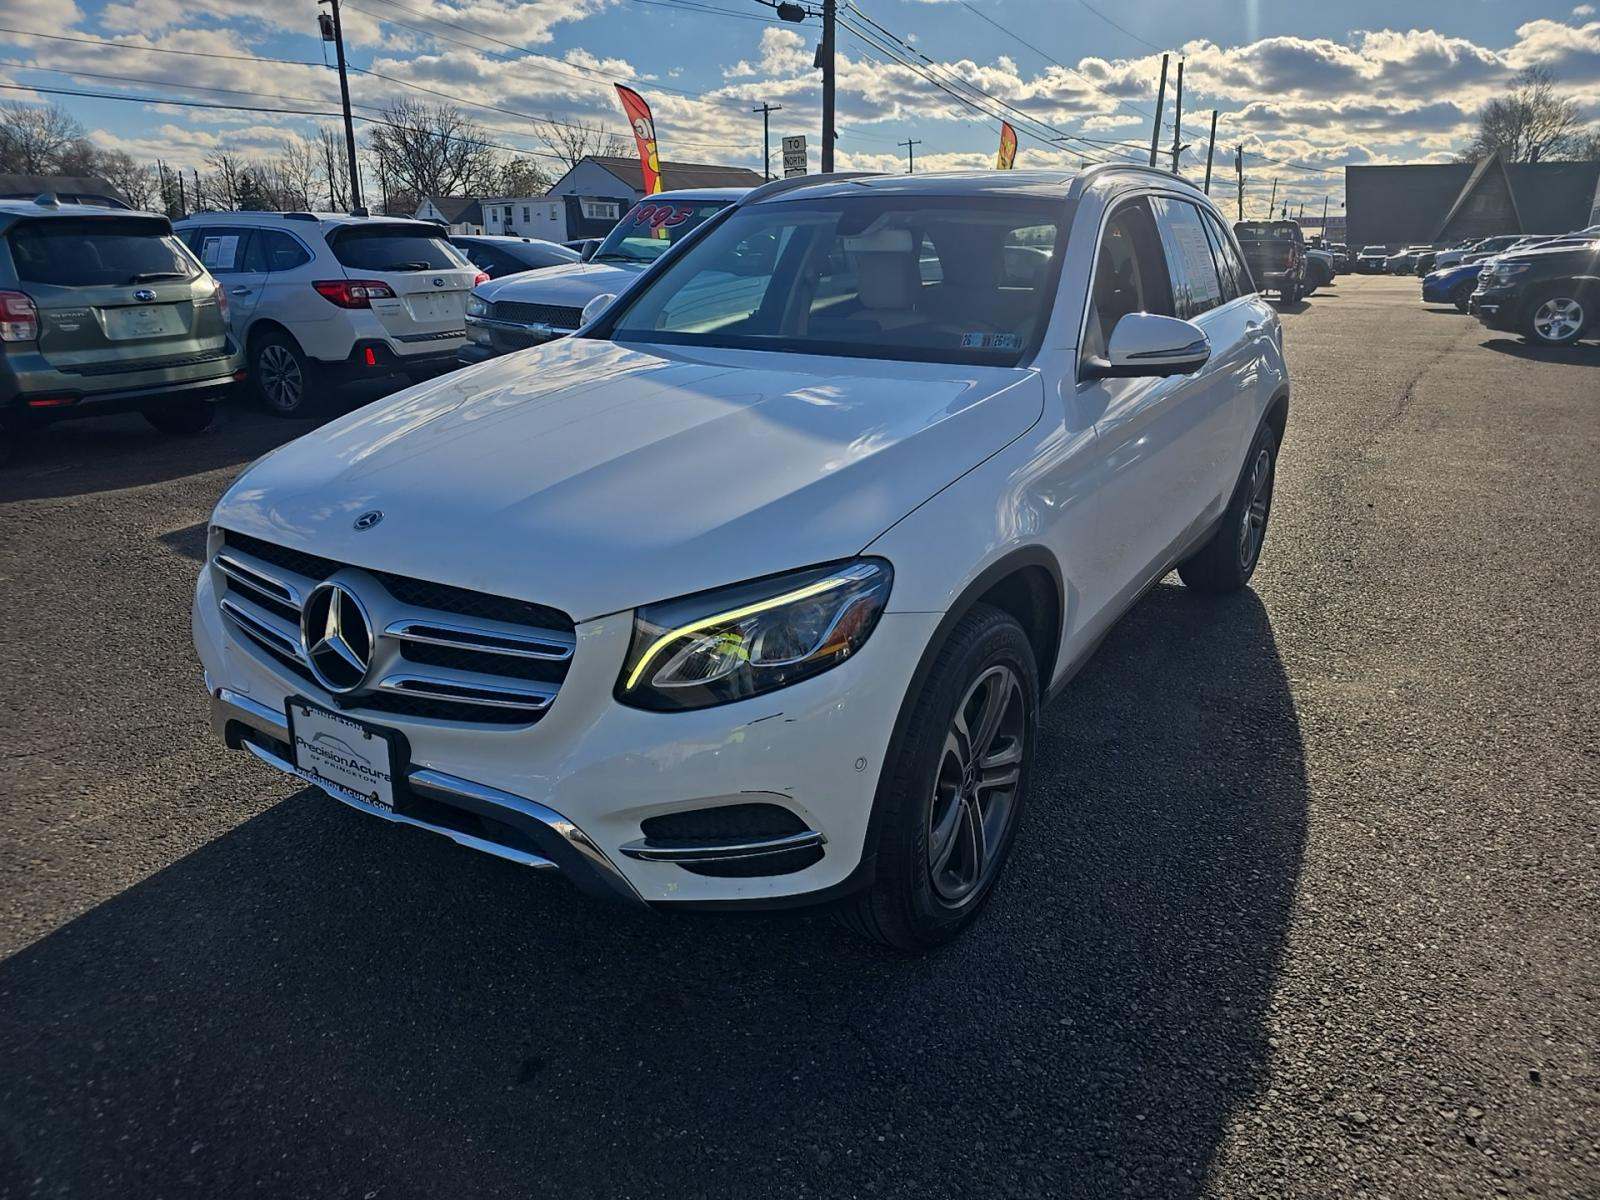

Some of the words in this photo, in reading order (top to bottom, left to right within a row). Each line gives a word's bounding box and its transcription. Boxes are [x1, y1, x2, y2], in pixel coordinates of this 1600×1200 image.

[788, 139, 799, 149] TO
[784, 155, 804, 168] NORTH
[310, 753, 320, 761] OF
[324, 760, 377, 785] PRINCETON
